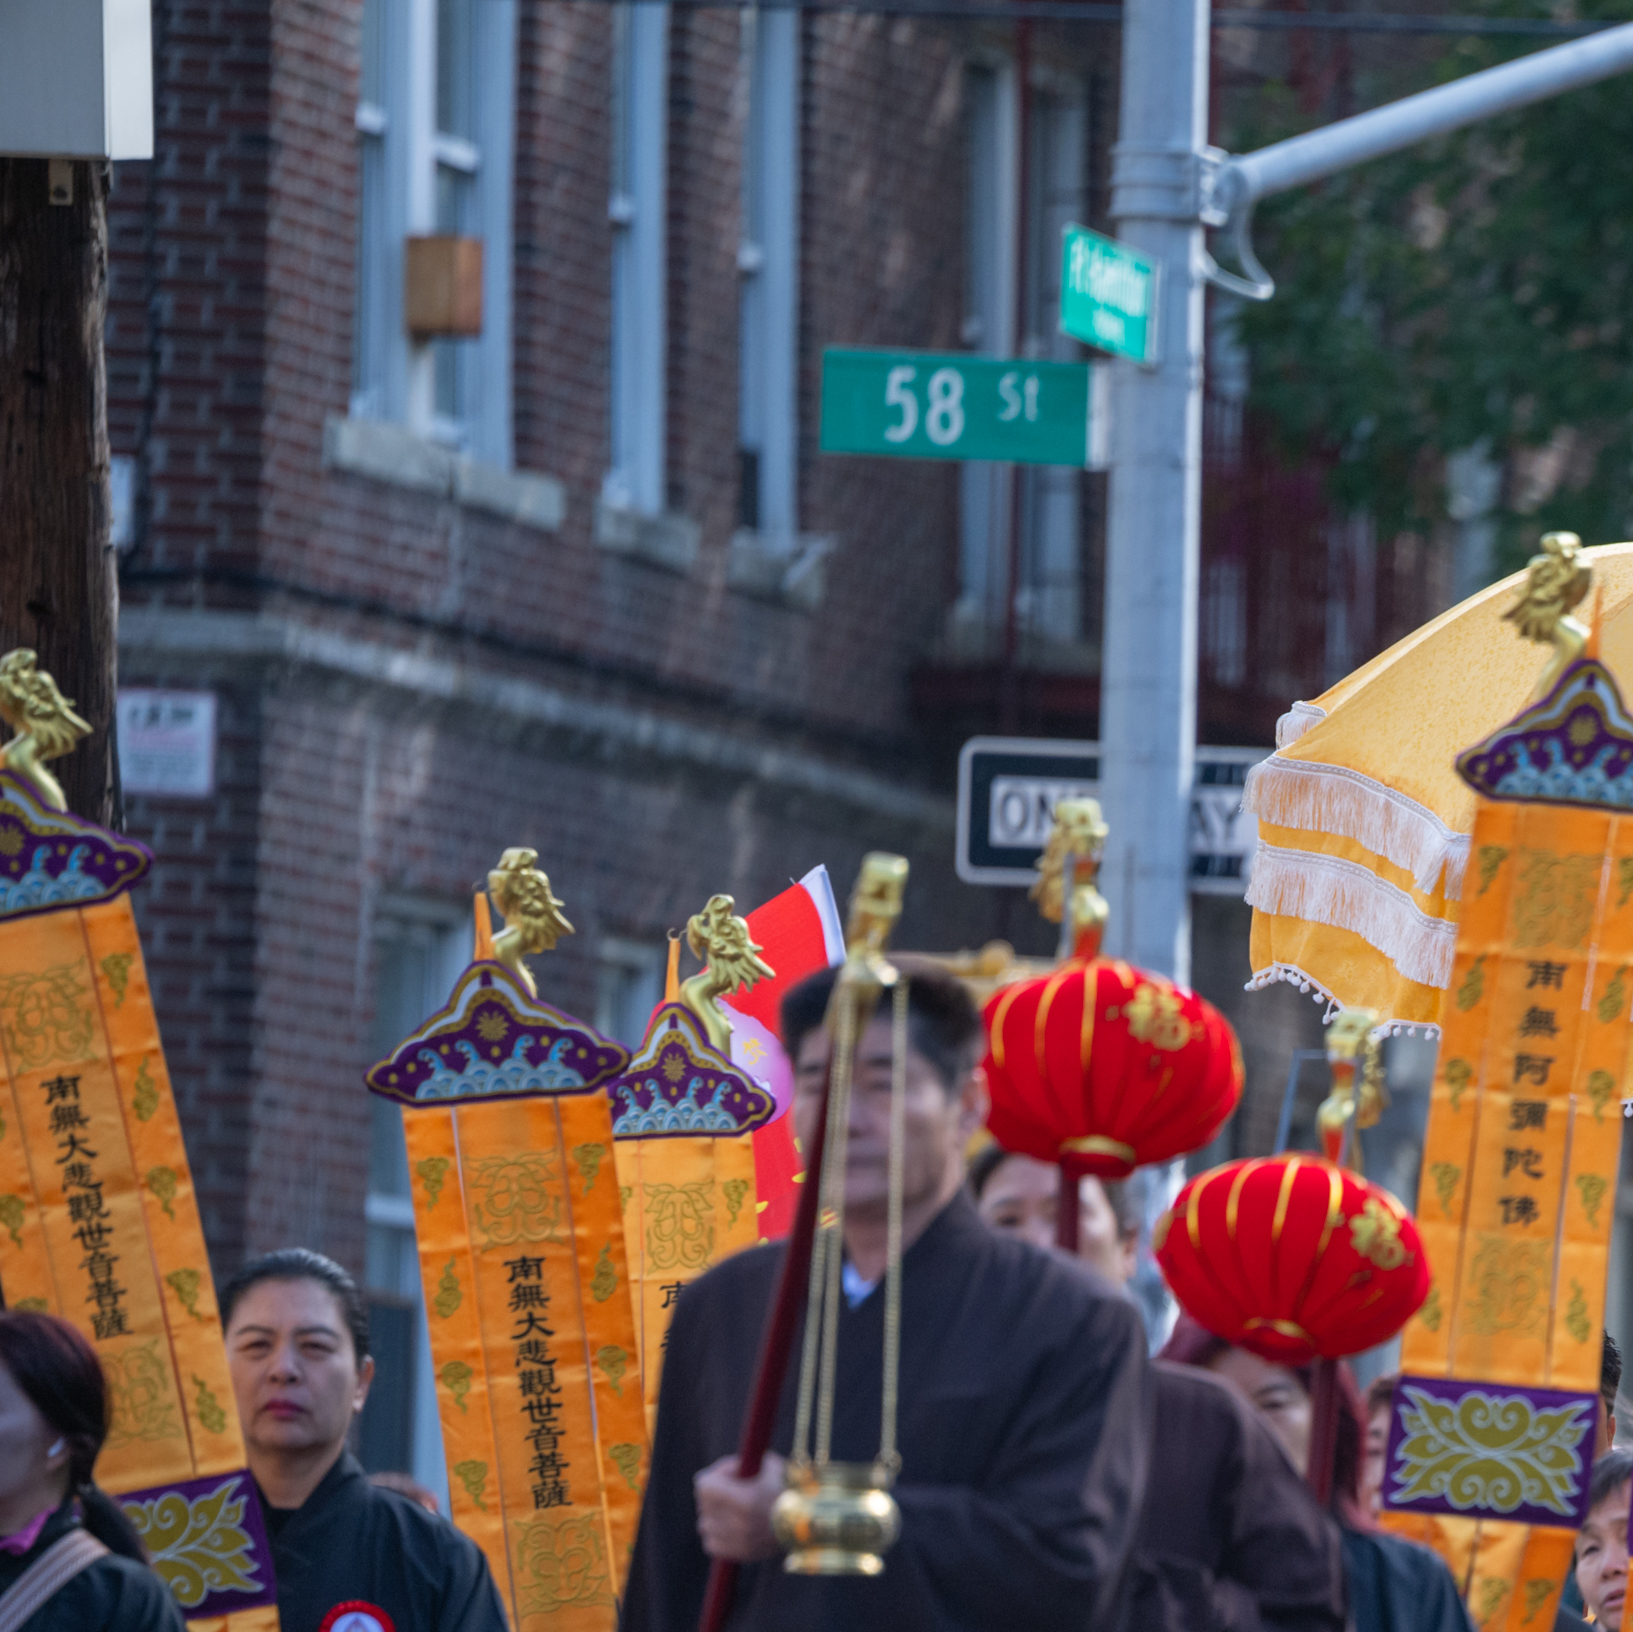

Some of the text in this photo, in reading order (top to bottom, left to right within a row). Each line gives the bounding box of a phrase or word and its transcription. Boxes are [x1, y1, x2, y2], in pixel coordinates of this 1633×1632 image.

[884, 364, 1040, 446] 58 St
[999, 791, 1082, 836] ON
[1188, 796, 1242, 848] AY
[1499, 960, 1569, 1227] 南無阿彌陀佛
[40, 1074, 133, 1340] 南無大悲觀世音菩薩
[503, 1256, 572, 1509] 南無大悲觀世音菩薩
